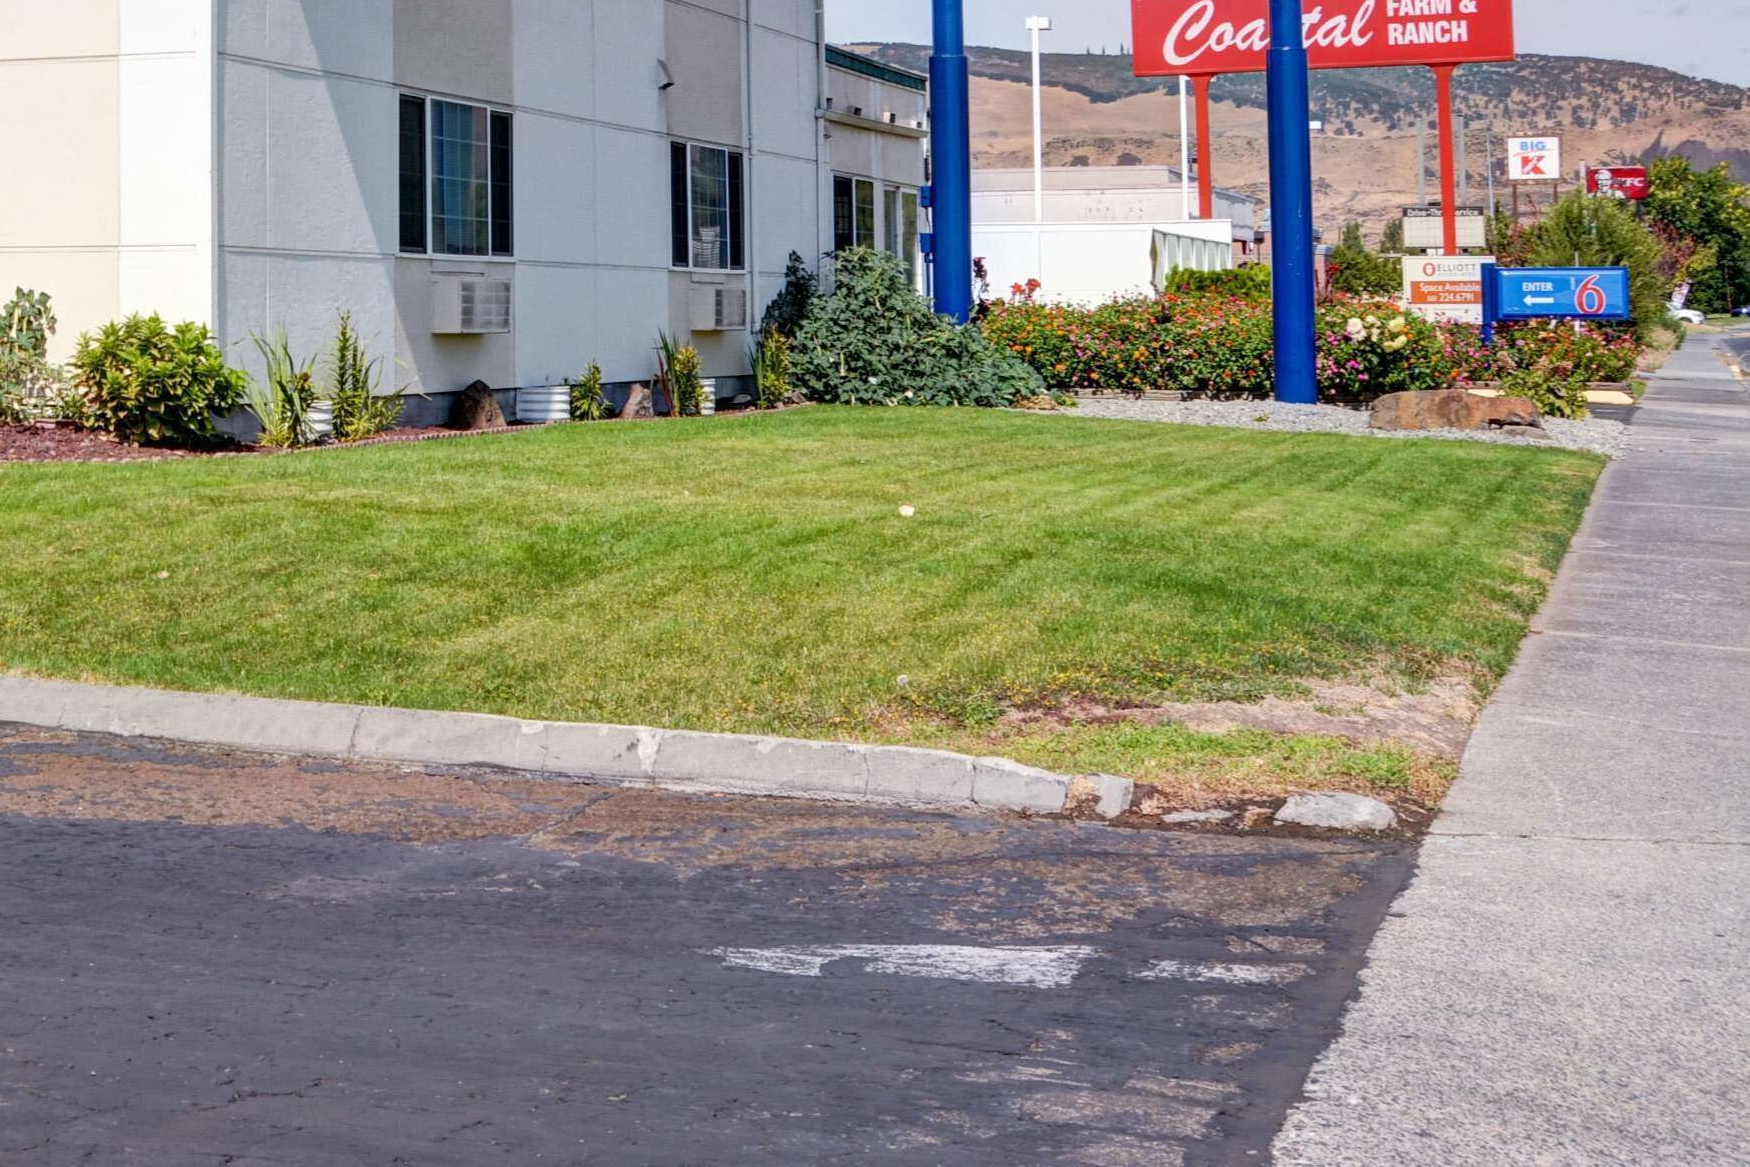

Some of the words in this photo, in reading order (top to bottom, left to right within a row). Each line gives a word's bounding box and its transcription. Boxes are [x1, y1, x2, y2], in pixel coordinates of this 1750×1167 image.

[1387, 20, 1469, 46] RANCH
[1519, 141, 1547, 152] BIG
[1520, 155, 1547, 175] K
[1436, 264, 1477, 273] ELLIOTT
[1521, 281, 1554, 292] ENTER
[1574, 273, 1607, 315] 6
